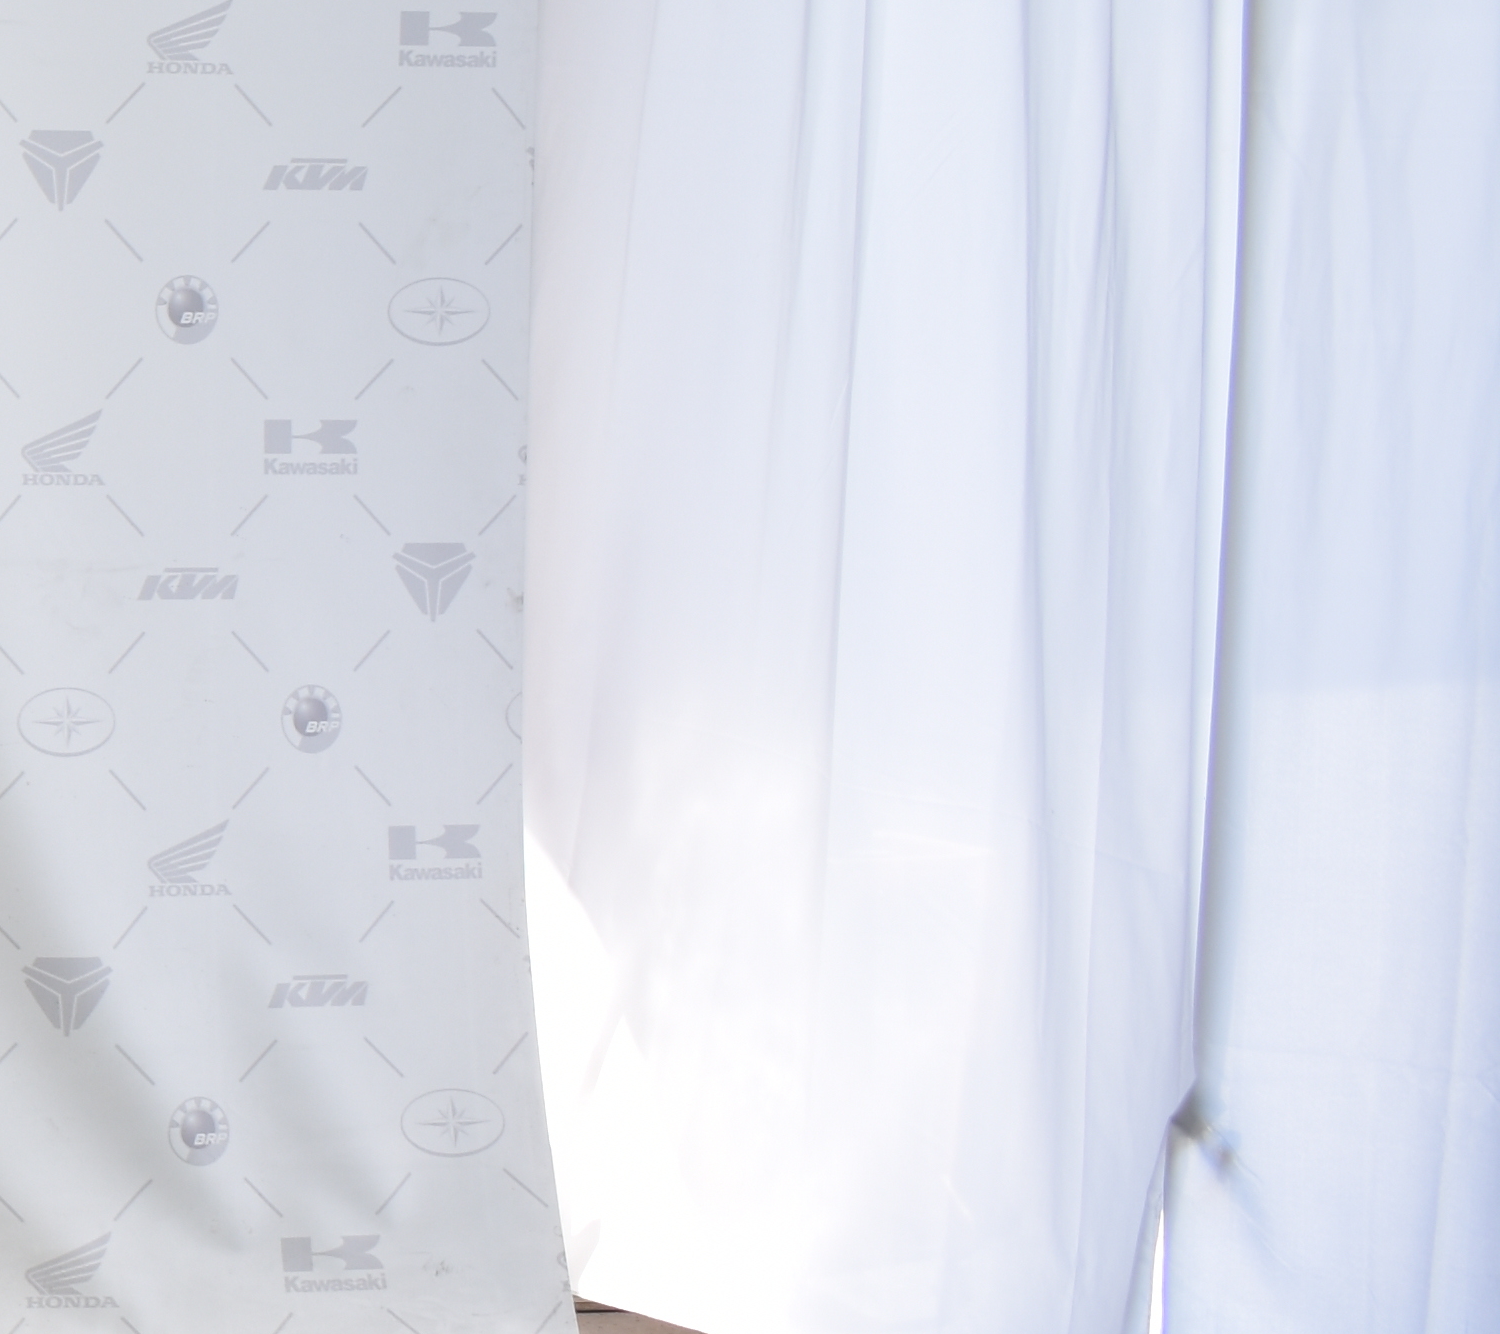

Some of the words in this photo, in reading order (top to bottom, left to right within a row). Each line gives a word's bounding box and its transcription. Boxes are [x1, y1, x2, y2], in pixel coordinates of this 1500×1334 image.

[147, 59, 233, 75] HONDA
[399, 50, 496, 68] Kawasaki
[264, 158, 368, 191] KTM
[264, 458, 358, 475] Kawasaki
[23, 472, 106, 486] HONDA
[138, 568, 238, 600] KTM
[307, 720, 338, 731] BRP
[389, 862, 482, 880] Kawasaki
[149, 882, 232, 897] HONDA
[267, 974, 368, 1009] KTM
[284, 1273, 388, 1292] Kawasaki
[27, 1293, 119, 1309] HONDA
